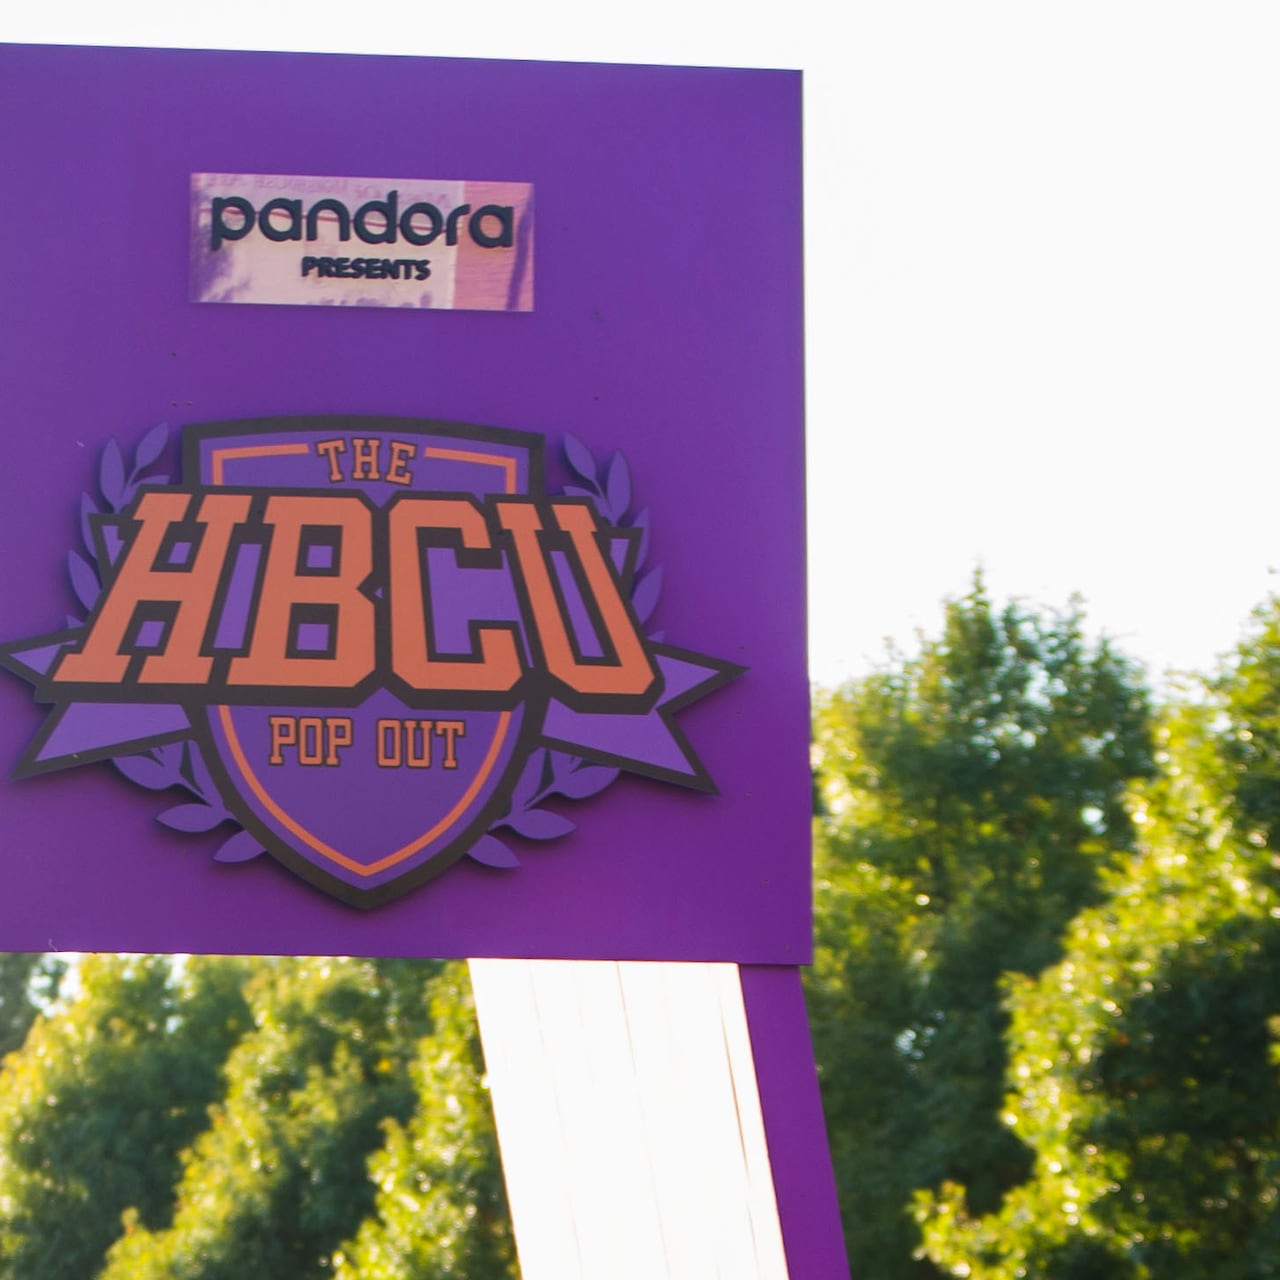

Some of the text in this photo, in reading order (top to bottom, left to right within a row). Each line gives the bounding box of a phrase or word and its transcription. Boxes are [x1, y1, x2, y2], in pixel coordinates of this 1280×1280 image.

[211, 190, 514, 252] pandora
[301, 256, 431, 281] PRESENTS
[316, 437, 417, 485] THE
[48, 489, 659, 697] HBCU
[269, 716, 466, 769] POP OUT
